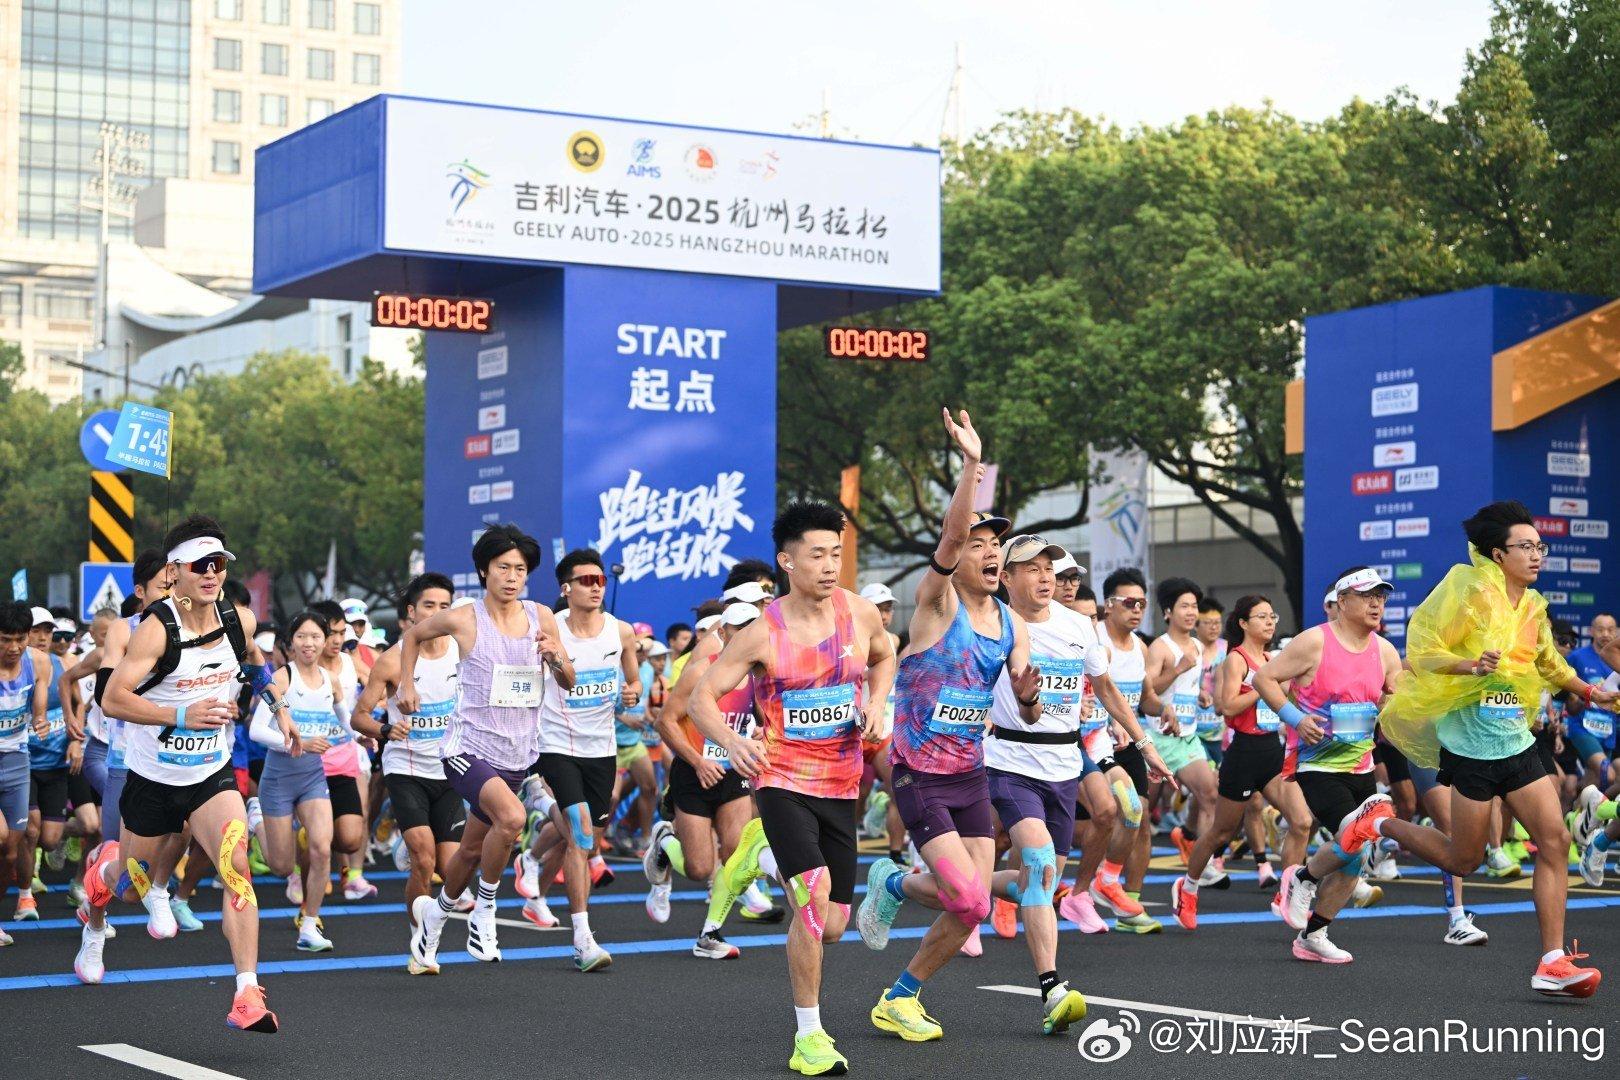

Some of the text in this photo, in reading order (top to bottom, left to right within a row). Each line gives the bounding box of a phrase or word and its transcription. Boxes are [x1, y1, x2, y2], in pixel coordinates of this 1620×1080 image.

[626, 164, 662, 179] AIMS
[513, 221, 566, 239] GEELY
[680, 234, 784, 257] HANGZHOU
[789, 242, 890, 265] MARATHON
[376, 294, 489, 332] 00:00:02
[616, 323, 727, 360] START
[830, 328, 927, 360] 00:00:02
[627, 366, 716, 414] 起点
[128, 422, 168, 458] 1:45
[569, 681, 613, 697] F01203
[788, 703, 851, 725] F00867
[938, 704, 988, 722] F00270
[164, 734, 219, 751] F00777
